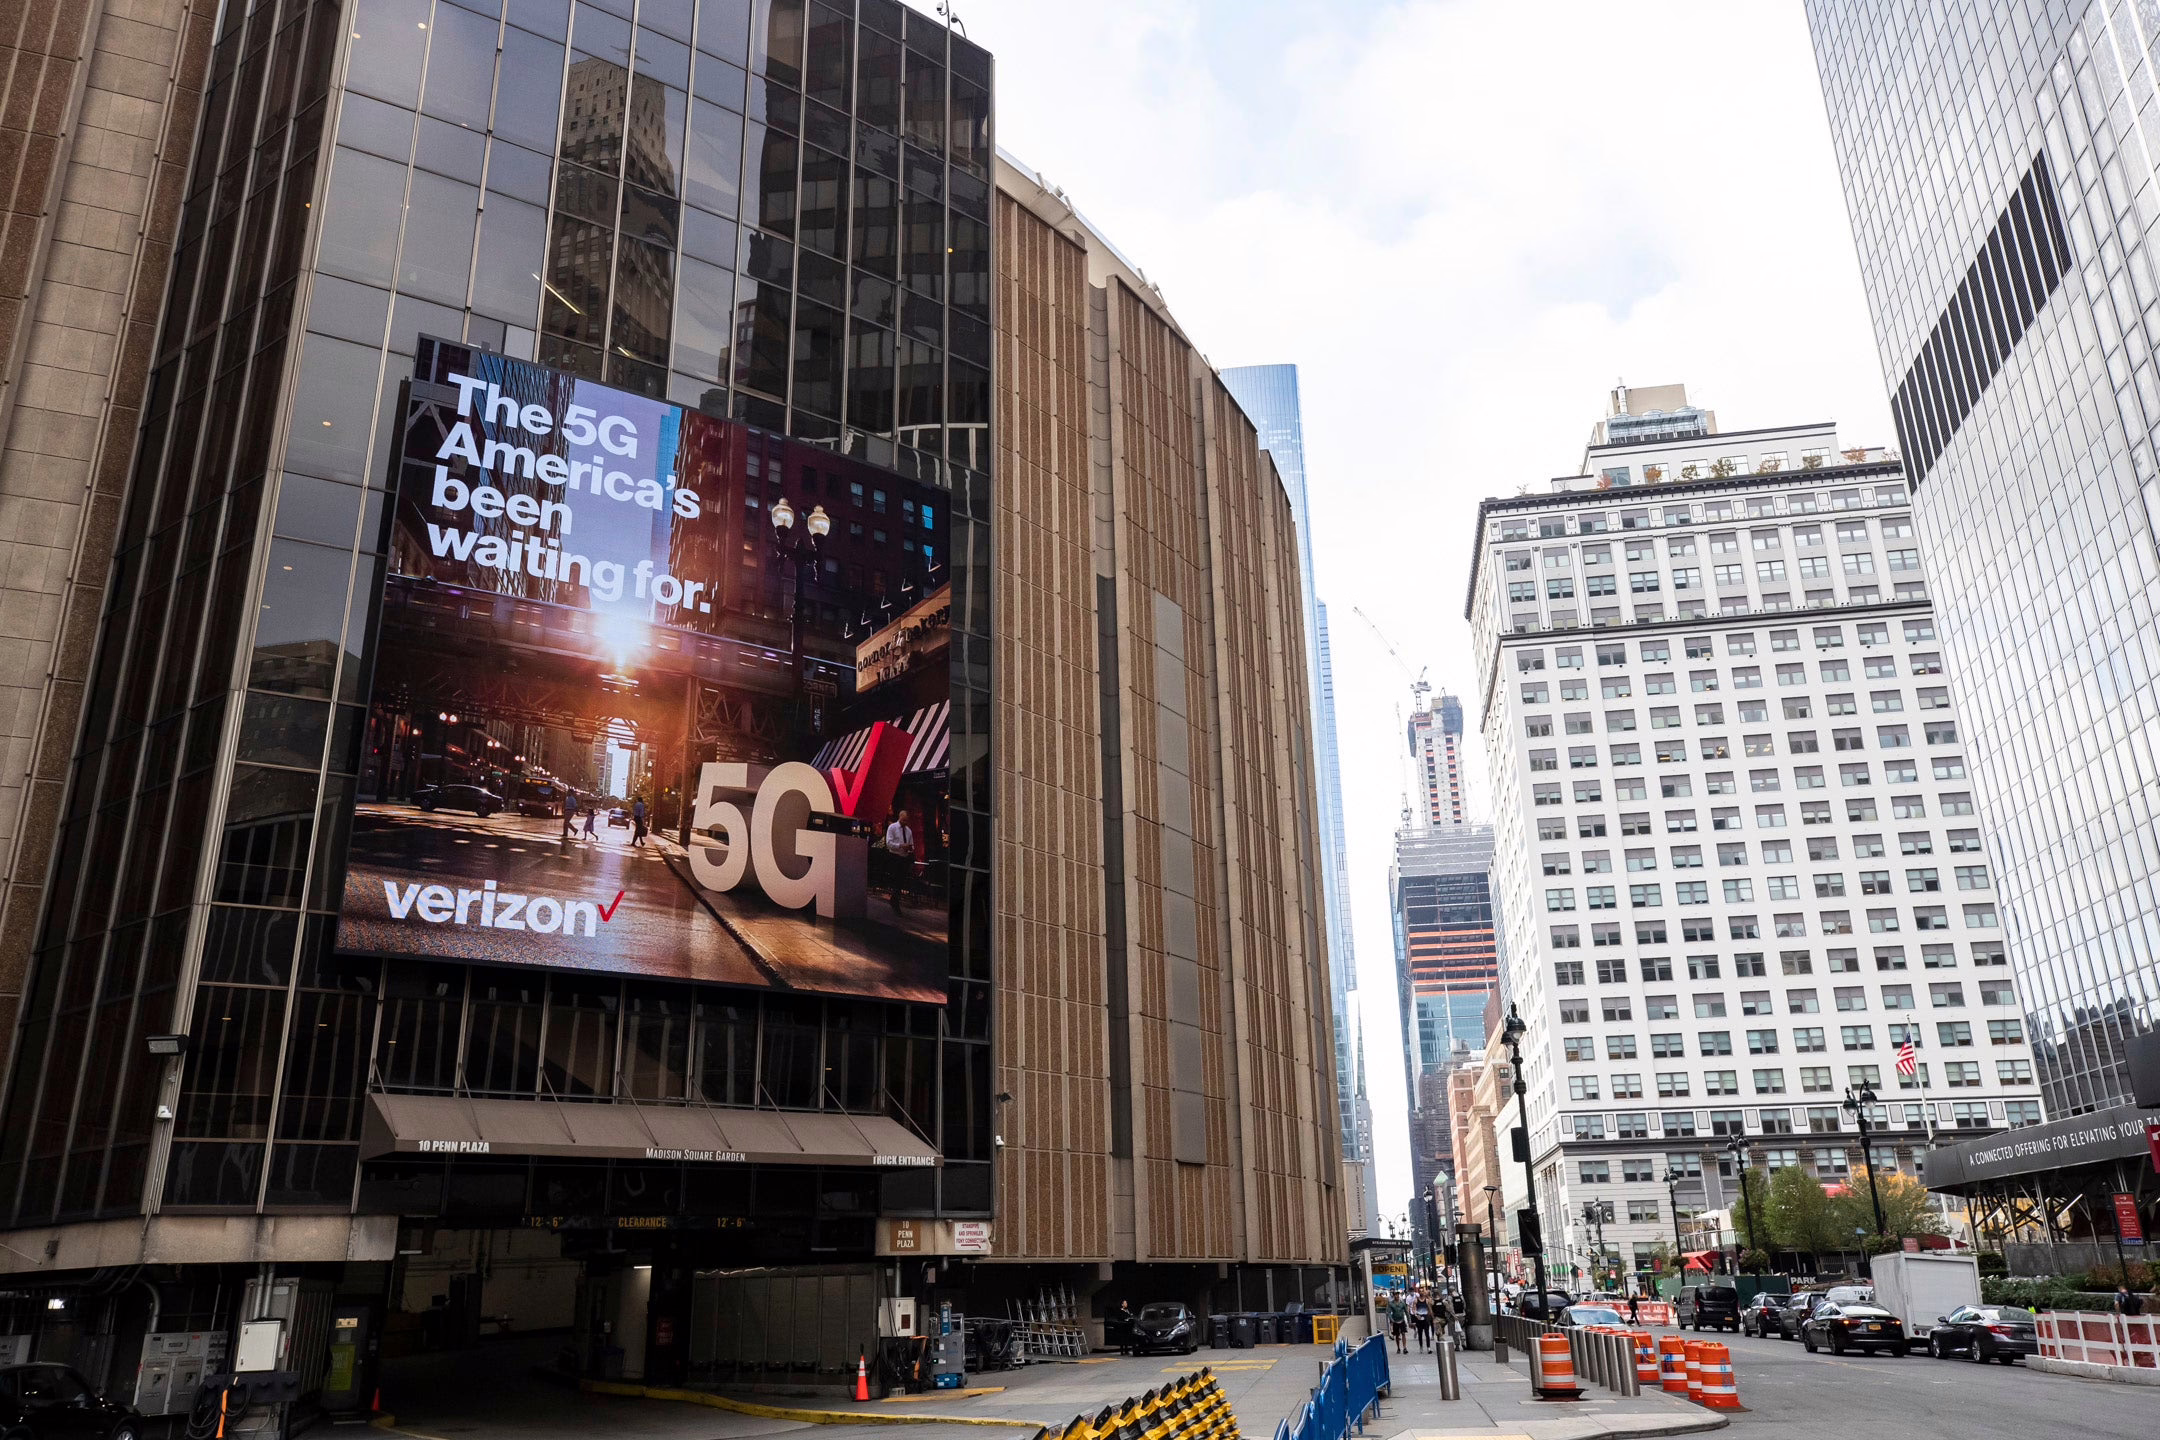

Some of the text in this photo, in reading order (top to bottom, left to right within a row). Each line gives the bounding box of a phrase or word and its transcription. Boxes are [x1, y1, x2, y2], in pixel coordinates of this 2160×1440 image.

[448, 372, 638, 459] The 5G
[435, 421, 700, 519] America's
[431, 465, 573, 535] been
[426, 522, 711, 614] waiting for.
[688, 761, 838, 919] 5G
[383, 879, 599, 938] verizon
[418, 1140, 490, 1153] 10 PENN PLAZA
[1969, 1154, 1975, 1166] A
[1975, 1146, 2014, 1165] CONNECTED
[2014, 1138, 2051, 1157] OFFERING
[2052, 1135, 2069, 1150] FOR
[2069, 1125, 2117, 1147] ELEVATING
[2118, 1119, 2146, 1138] YOUR
[645, 1147, 746, 1162] MADISON SQUARE GARDEN
[873, 1155, 935, 1166] TRUCK ENTRANCE
[618, 1216, 667, 1229] CLEARANCE
[902, 1221, 910, 1229] 10
[898, 1230, 913, 1239] PENN
[896, 1240, 914, 1248] PLAZA
[1378, 1265, 1404, 1273] OPEN!
[1790, 1276, 1817, 1284] PARK
